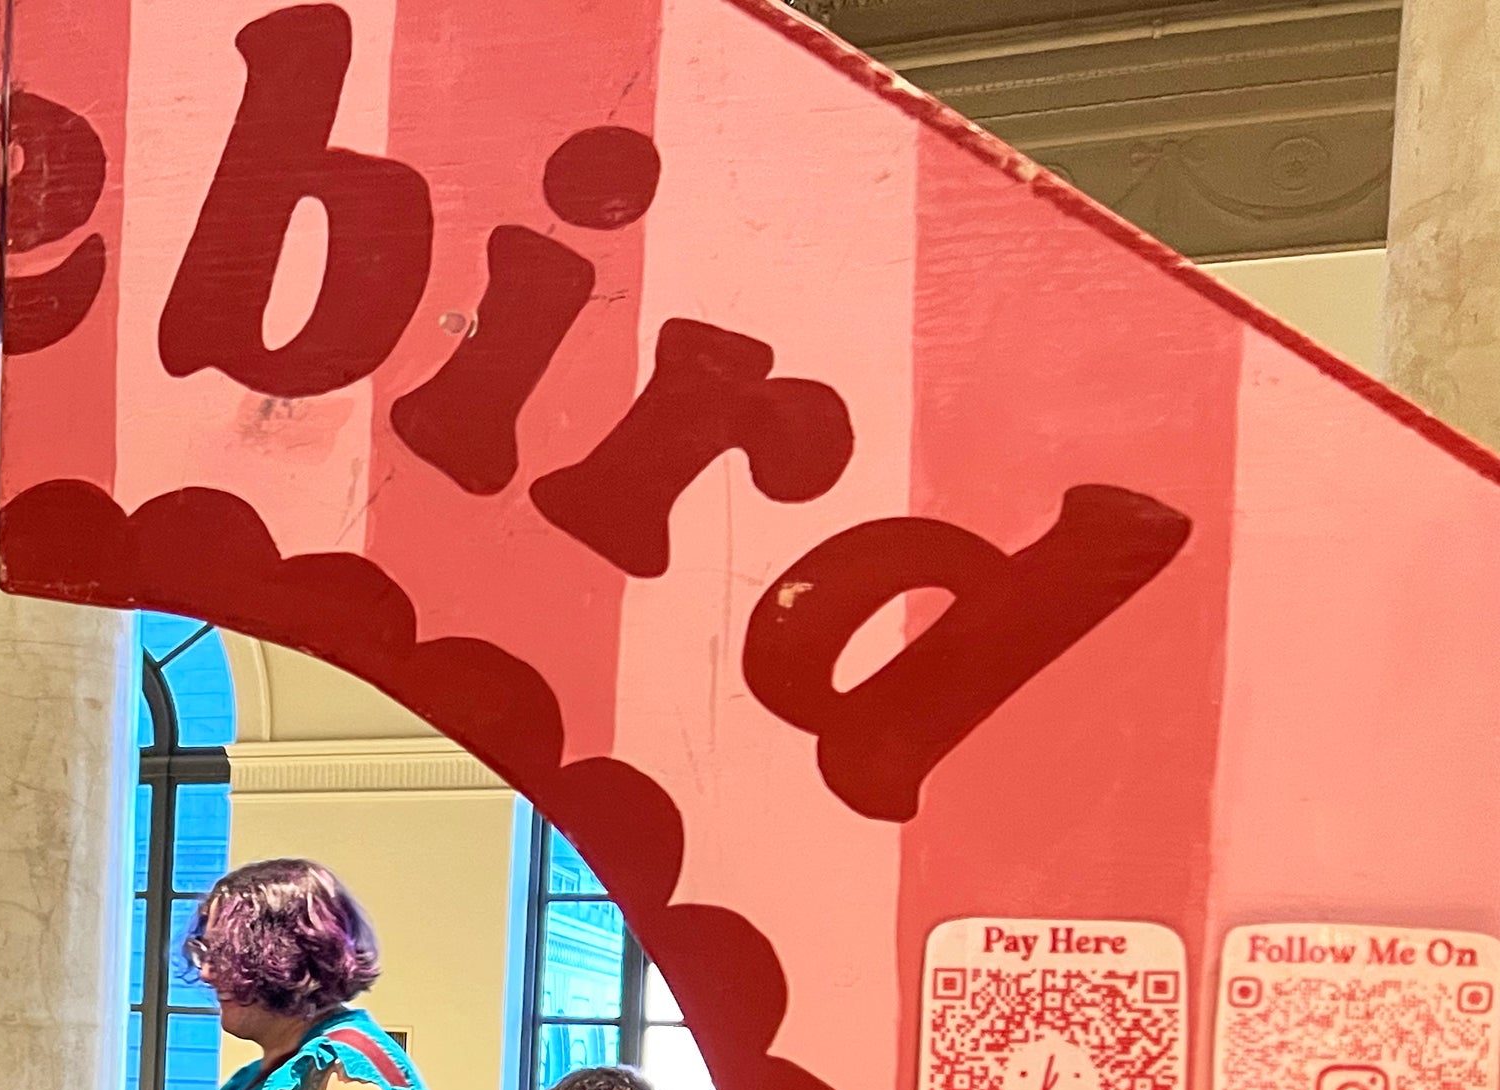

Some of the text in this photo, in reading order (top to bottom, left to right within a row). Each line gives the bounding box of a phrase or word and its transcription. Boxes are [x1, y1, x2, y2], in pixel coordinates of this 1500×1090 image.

[983, 926, 1127, 960] Pay Here
[1248, 935, 1478, 967] Follow Me On
